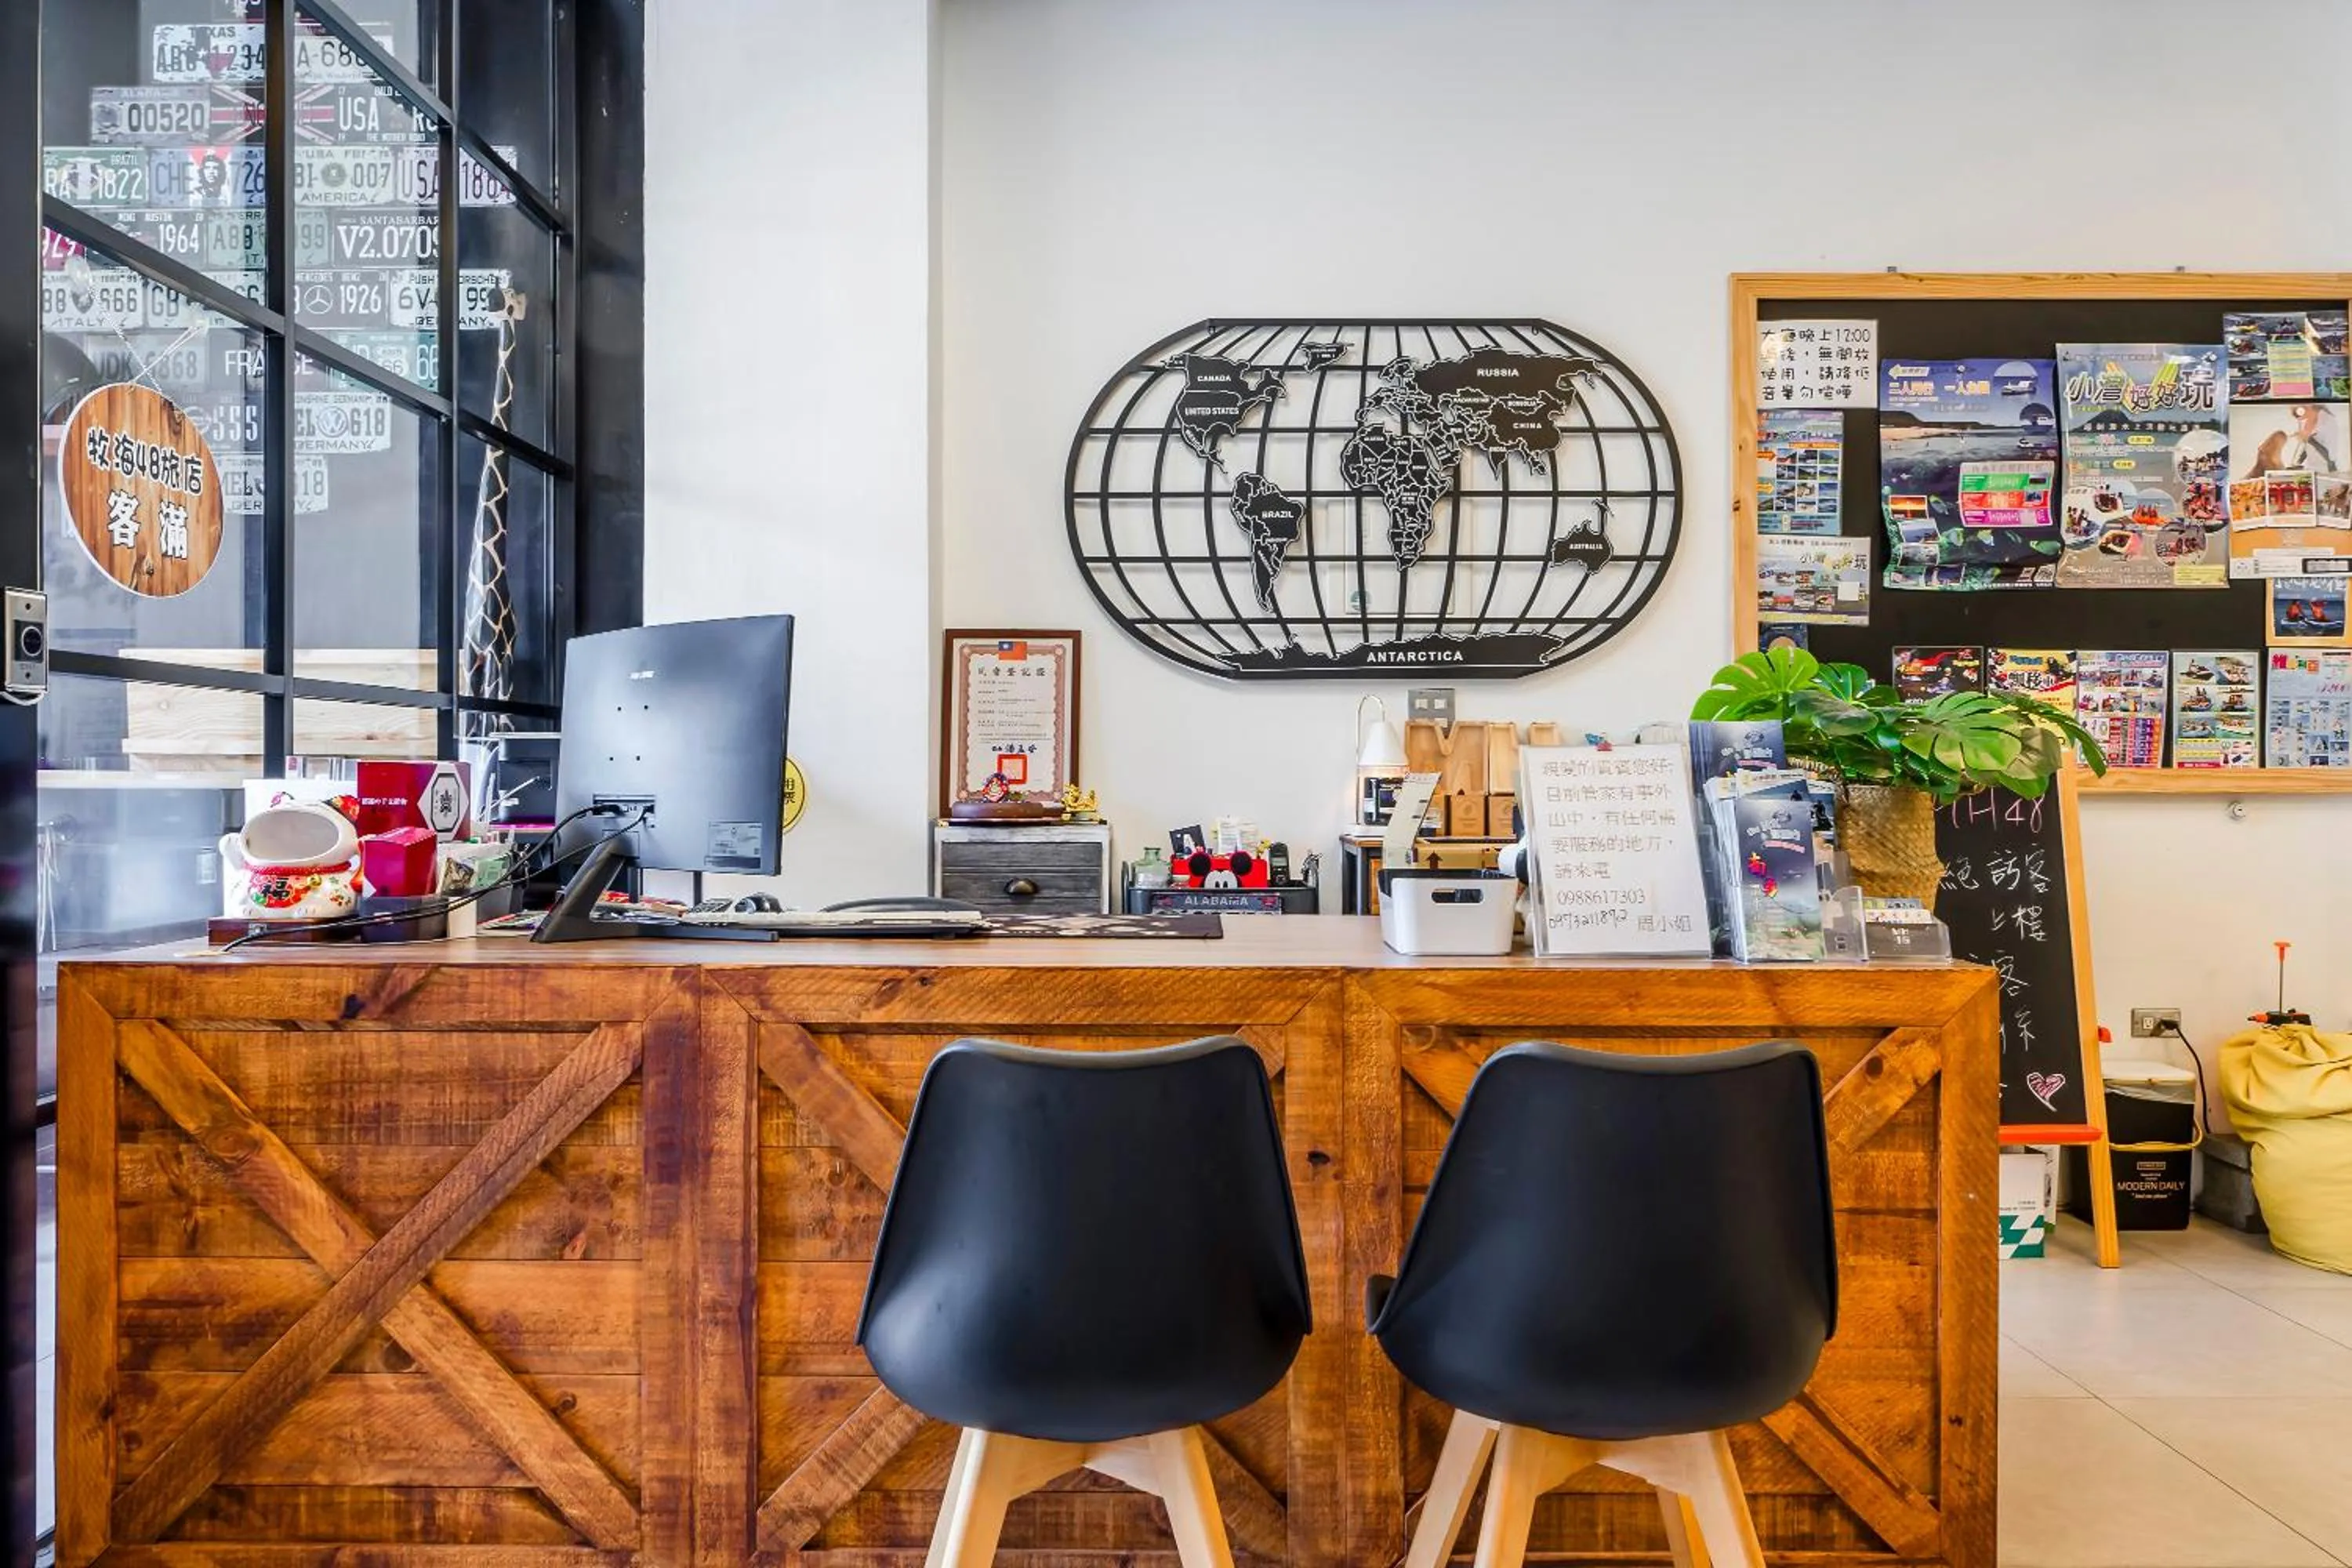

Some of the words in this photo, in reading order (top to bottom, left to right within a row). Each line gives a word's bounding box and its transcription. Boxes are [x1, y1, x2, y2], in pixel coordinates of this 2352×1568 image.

[188, 27, 235, 38] TXAS
[129, 103, 205, 132] 00520
[339, 97, 379, 132] USA
[97, 169, 143, 199] 1822
[354, 163, 390, 188] 007
[301, 193, 366, 202] AMERICA
[159, 224, 199, 253] 1964
[340, 285, 382, 314] 1926
[416, 317, 490, 327] GEANY
[1477, 368, 1519, 377] RUSSIA
[87, 427, 202, 495] 牧海48旅店
[107, 489, 188, 559] 客滿
[1367, 652, 1464, 663] ANTARCTICA
[1185, 896, 1249, 906] ALABAMA
[2118, 1181, 2158, 1191] MODERN
[2159, 1181, 2186, 1191] DAILY
